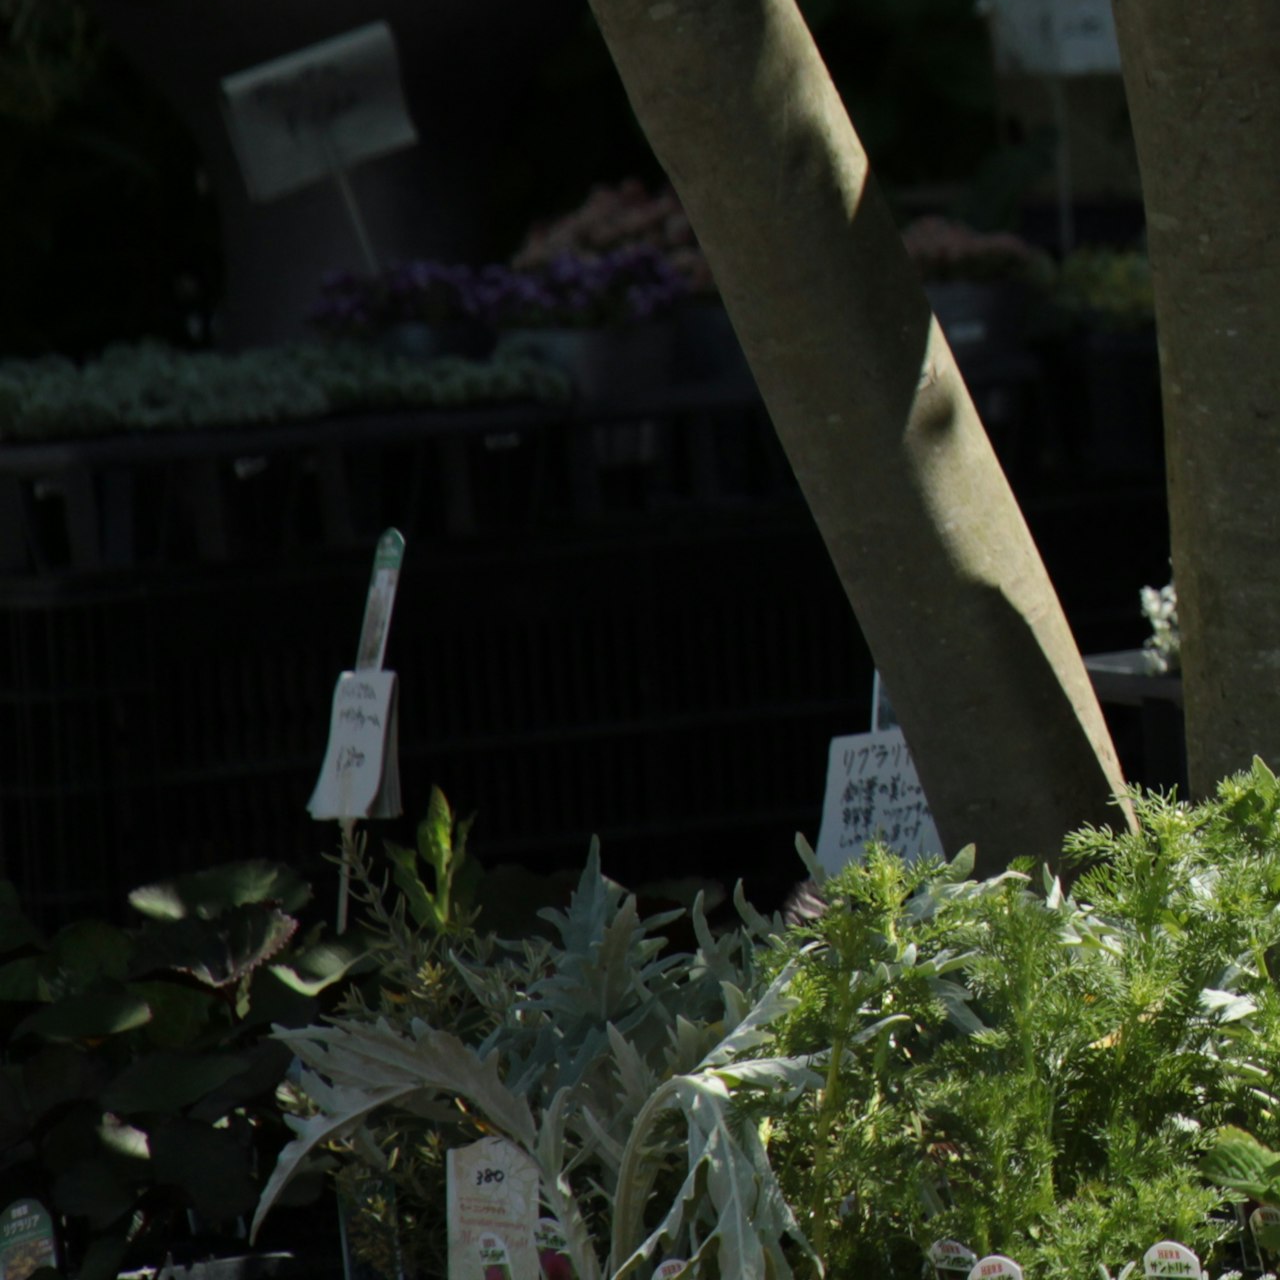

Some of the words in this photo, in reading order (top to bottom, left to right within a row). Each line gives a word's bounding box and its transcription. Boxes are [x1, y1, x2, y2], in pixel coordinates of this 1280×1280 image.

[475, 1167, 505, 1185] 380
[3, 1213, 41, 1238] リグラリア
[1157, 1248, 1181, 1260] HERB
[1150, 1260, 1192, 1275] サントリナ
